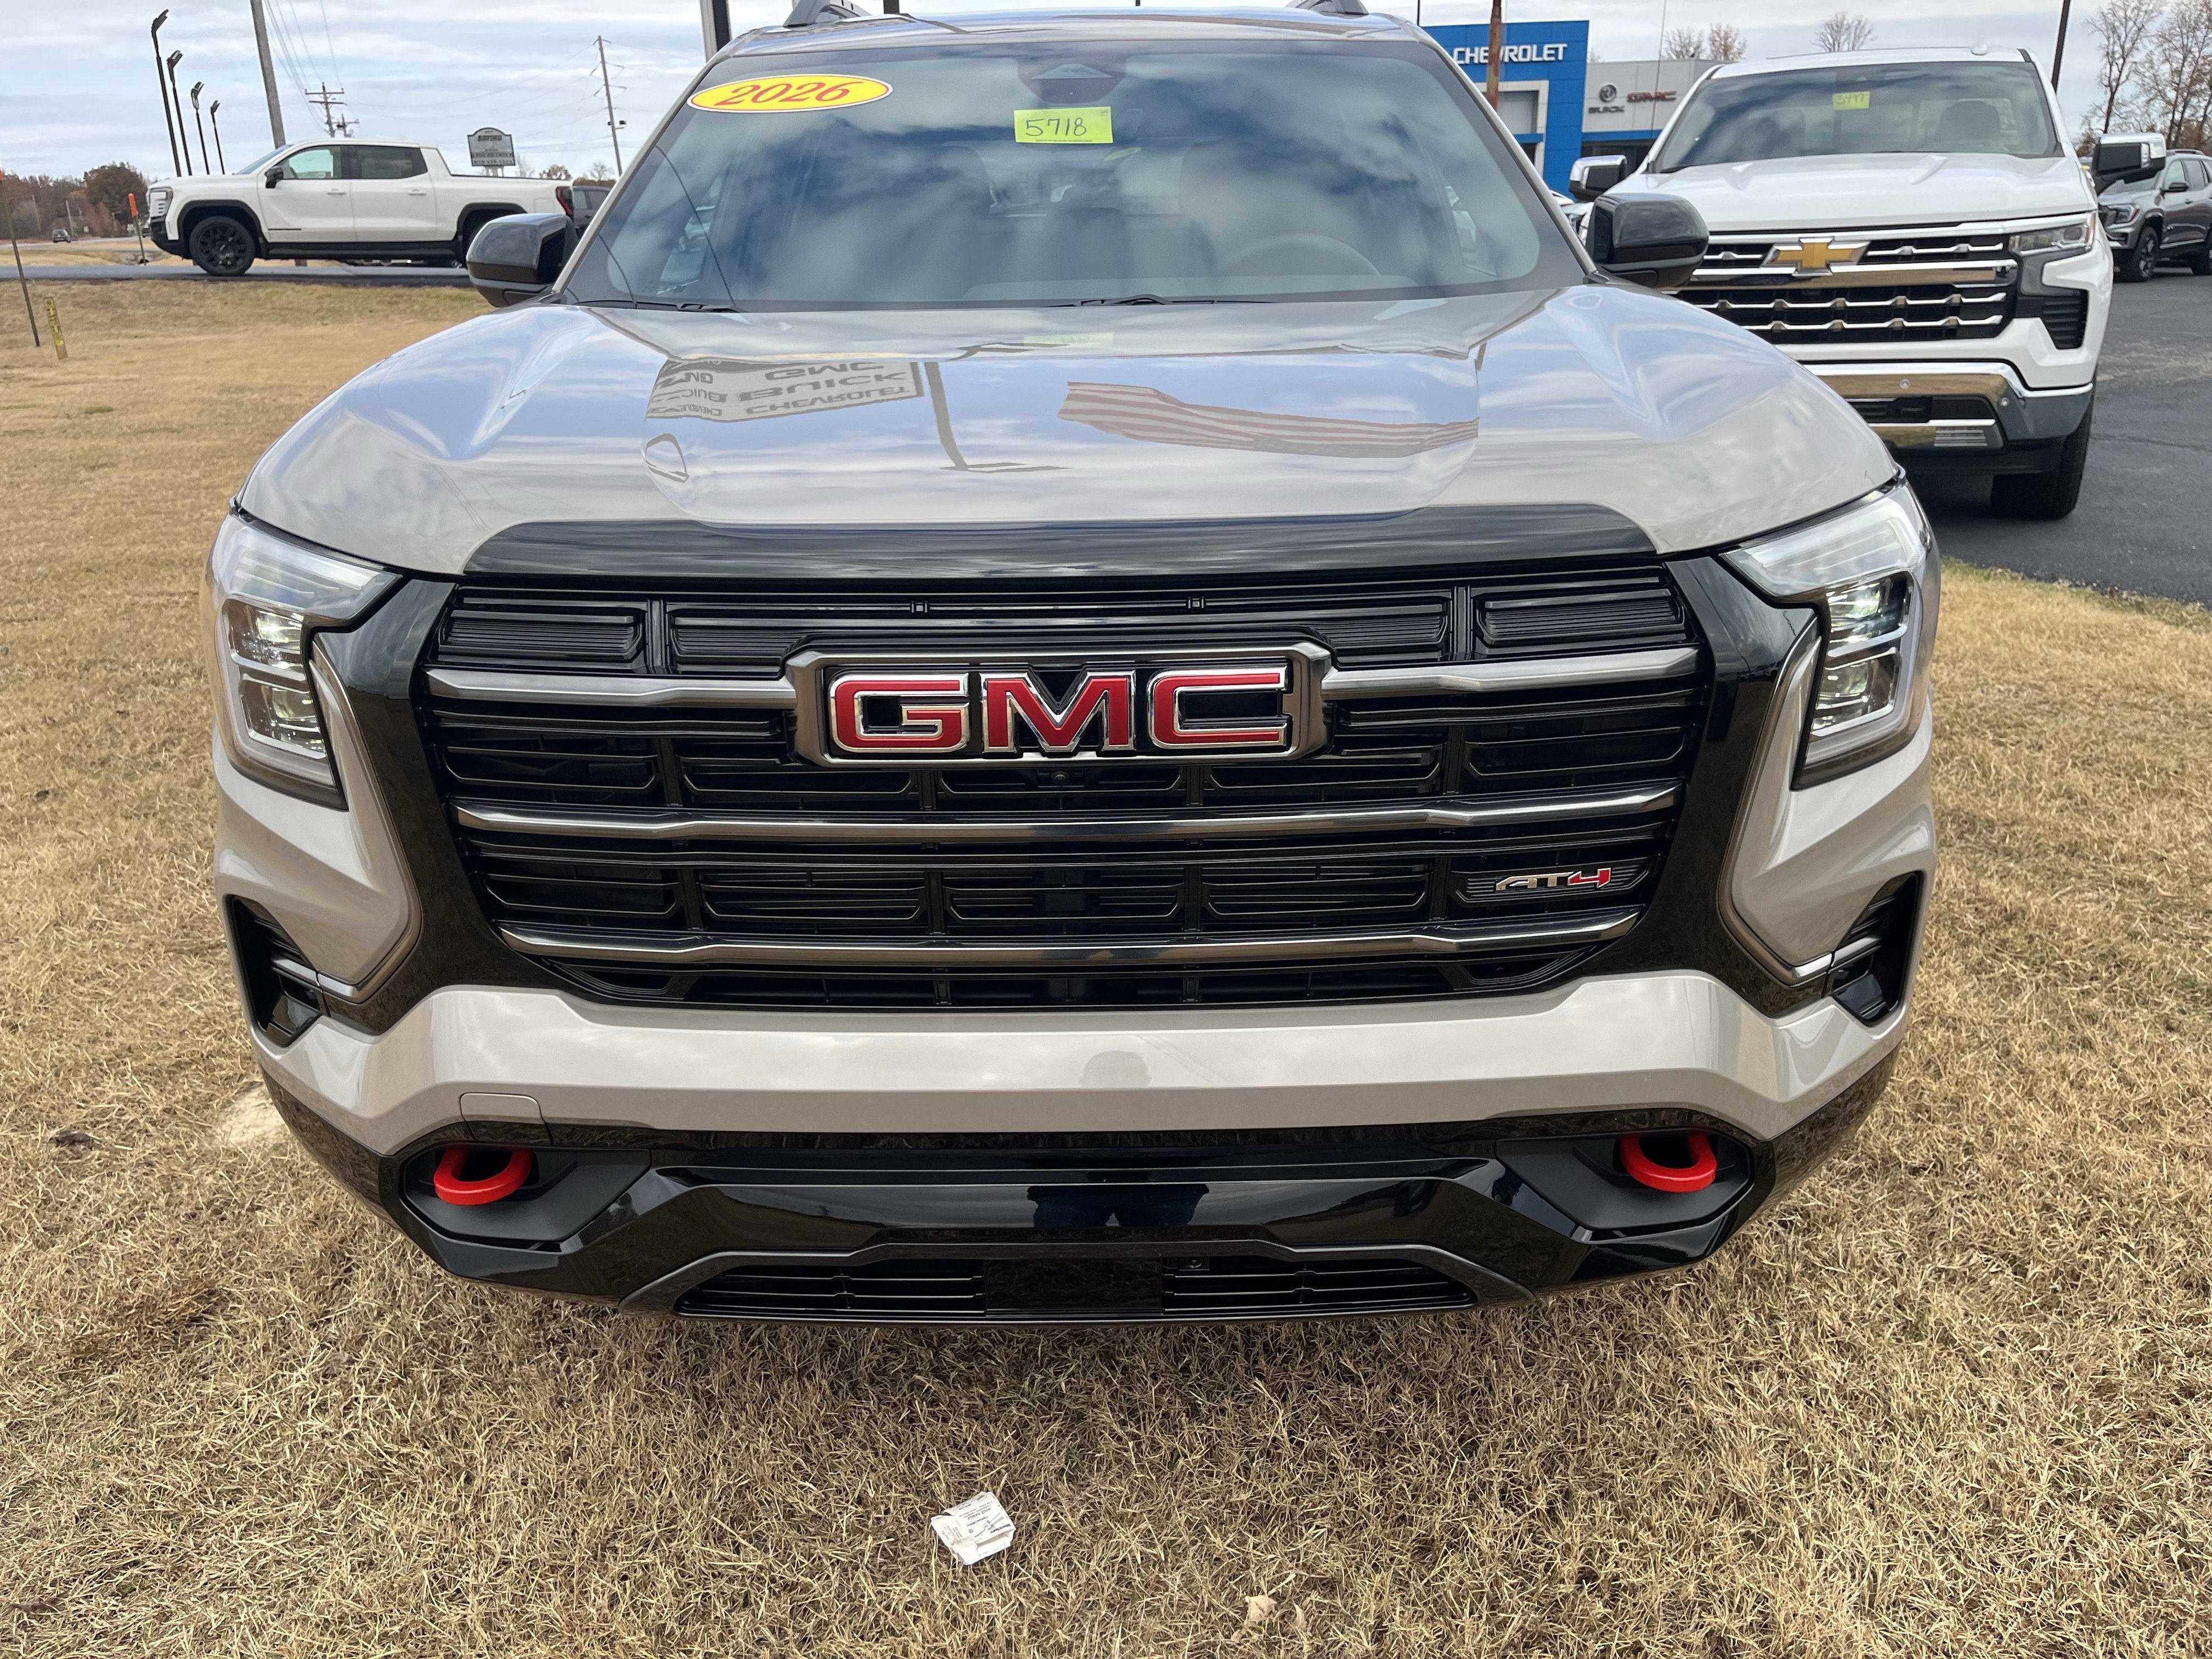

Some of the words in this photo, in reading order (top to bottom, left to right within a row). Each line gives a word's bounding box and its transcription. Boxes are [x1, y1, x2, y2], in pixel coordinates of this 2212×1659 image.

[714, 82, 864, 106] 2026
[1025, 117, 1087, 137] 5718
[827, 665, 1288, 754] GMC
[1495, 867, 1612, 891] AT4
